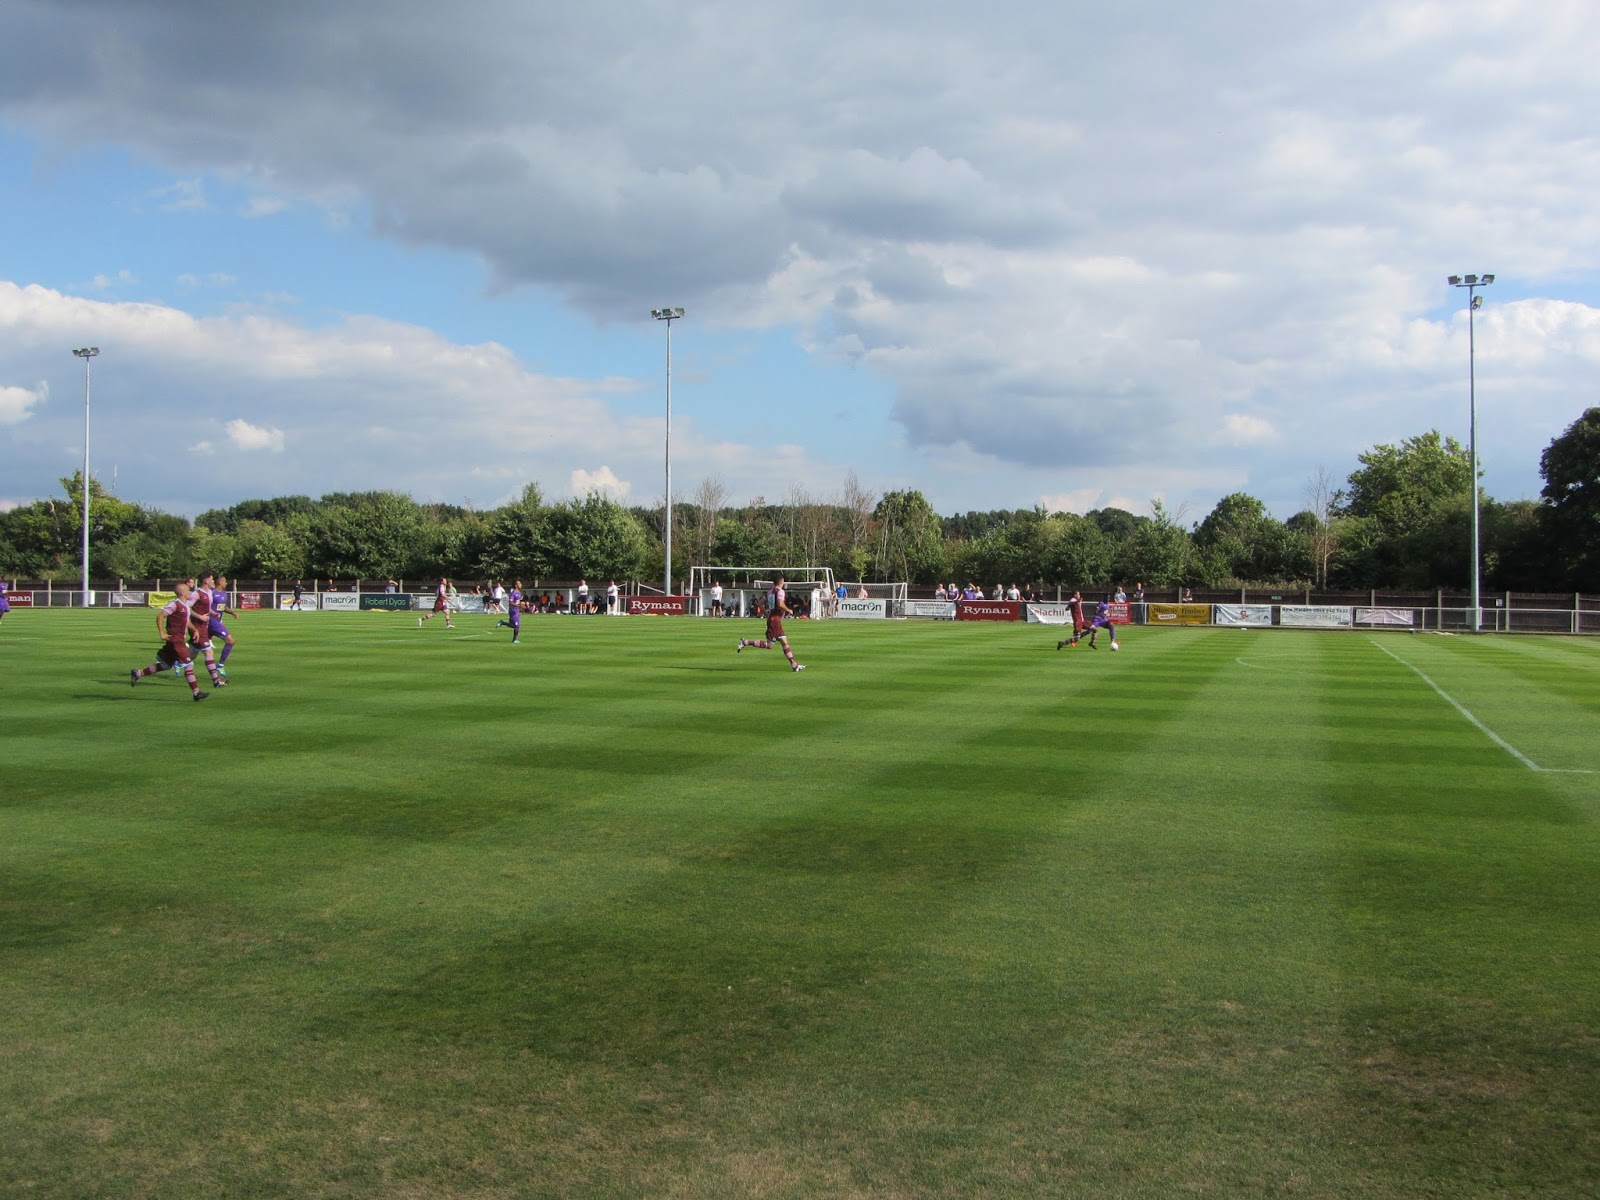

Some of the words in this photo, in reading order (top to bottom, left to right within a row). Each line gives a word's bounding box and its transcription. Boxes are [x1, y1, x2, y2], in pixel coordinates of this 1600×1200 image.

[325, 596, 357, 604] macron
[365, 598, 388, 606] Robert
[389, 598, 407, 607] Dyas
[631, 600, 683, 611] Ryman
[841, 602, 882, 612] macron
[963, 606, 1011, 615] Ryman
